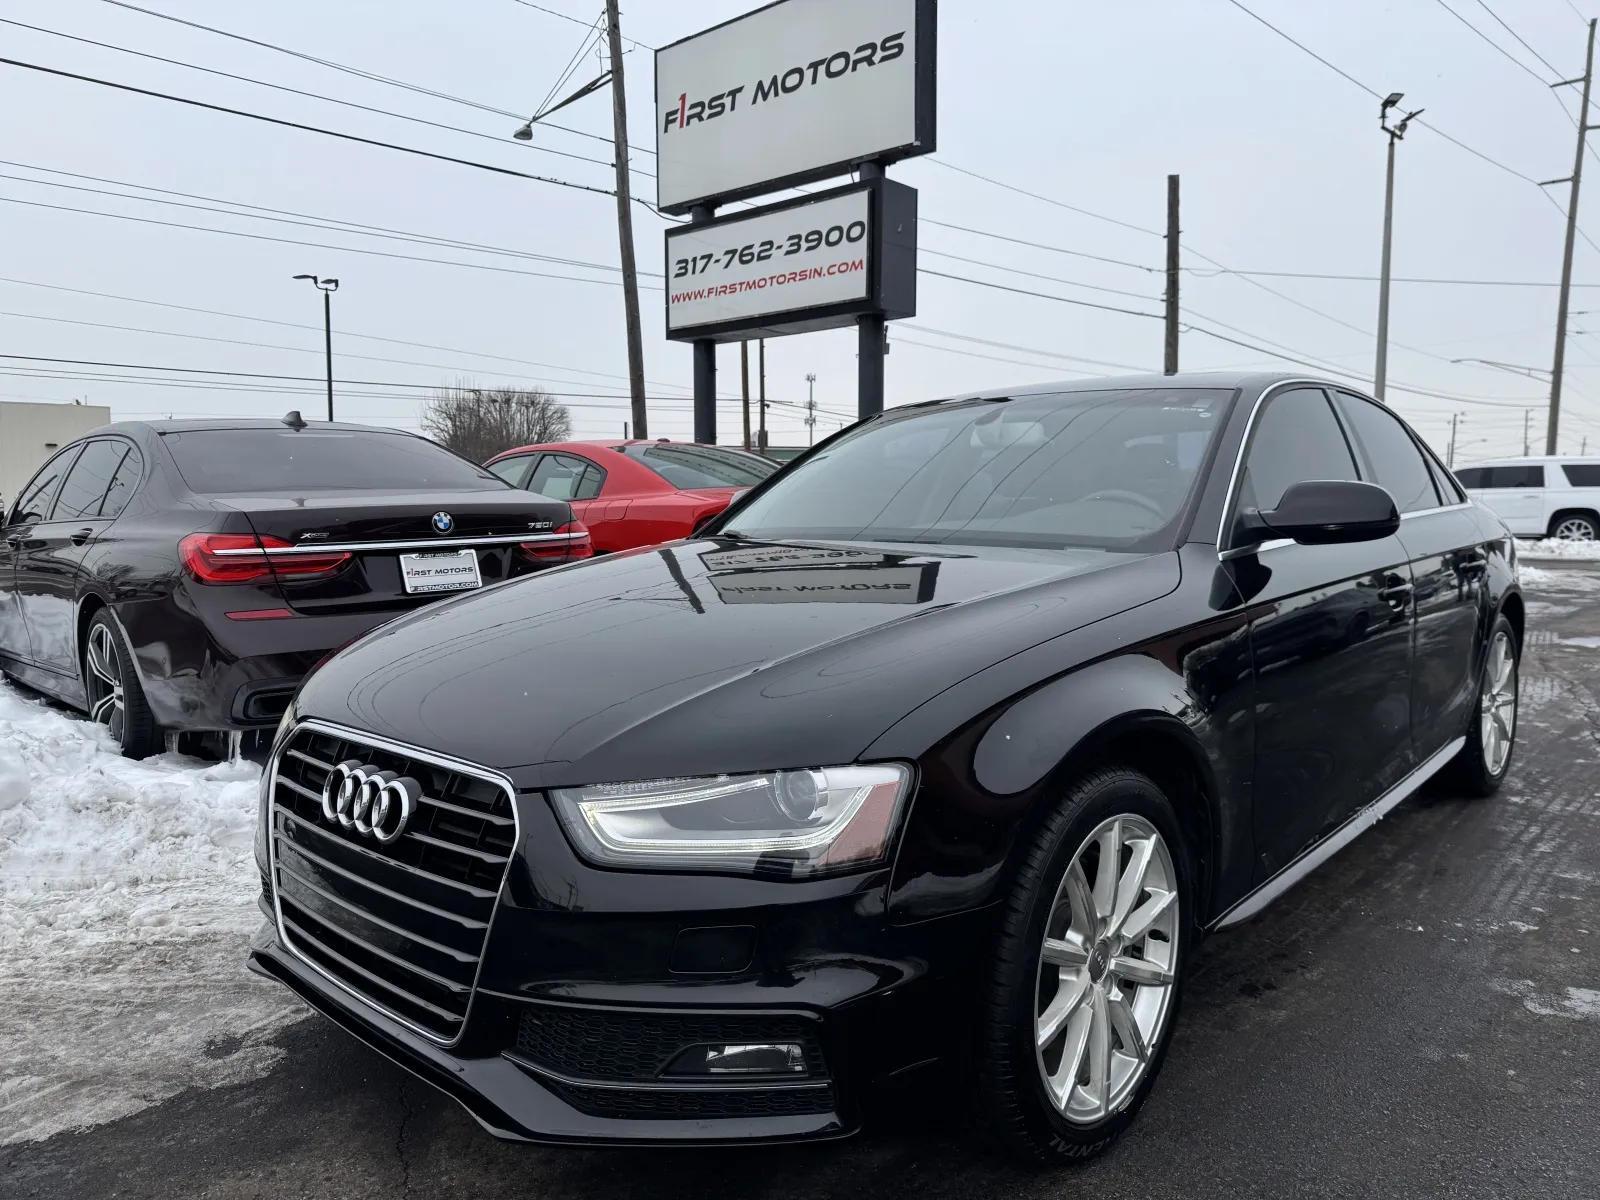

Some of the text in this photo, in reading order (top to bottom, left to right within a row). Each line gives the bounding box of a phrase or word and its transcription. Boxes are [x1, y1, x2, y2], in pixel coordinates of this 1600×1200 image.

[751, 31, 906, 106] MOTORS
[673, 220, 866, 279] 317-762-3900
[671, 259, 864, 304] WWW.FIRSTMOTORSIN.COM
[434, 566, 474, 575] MOTORS
